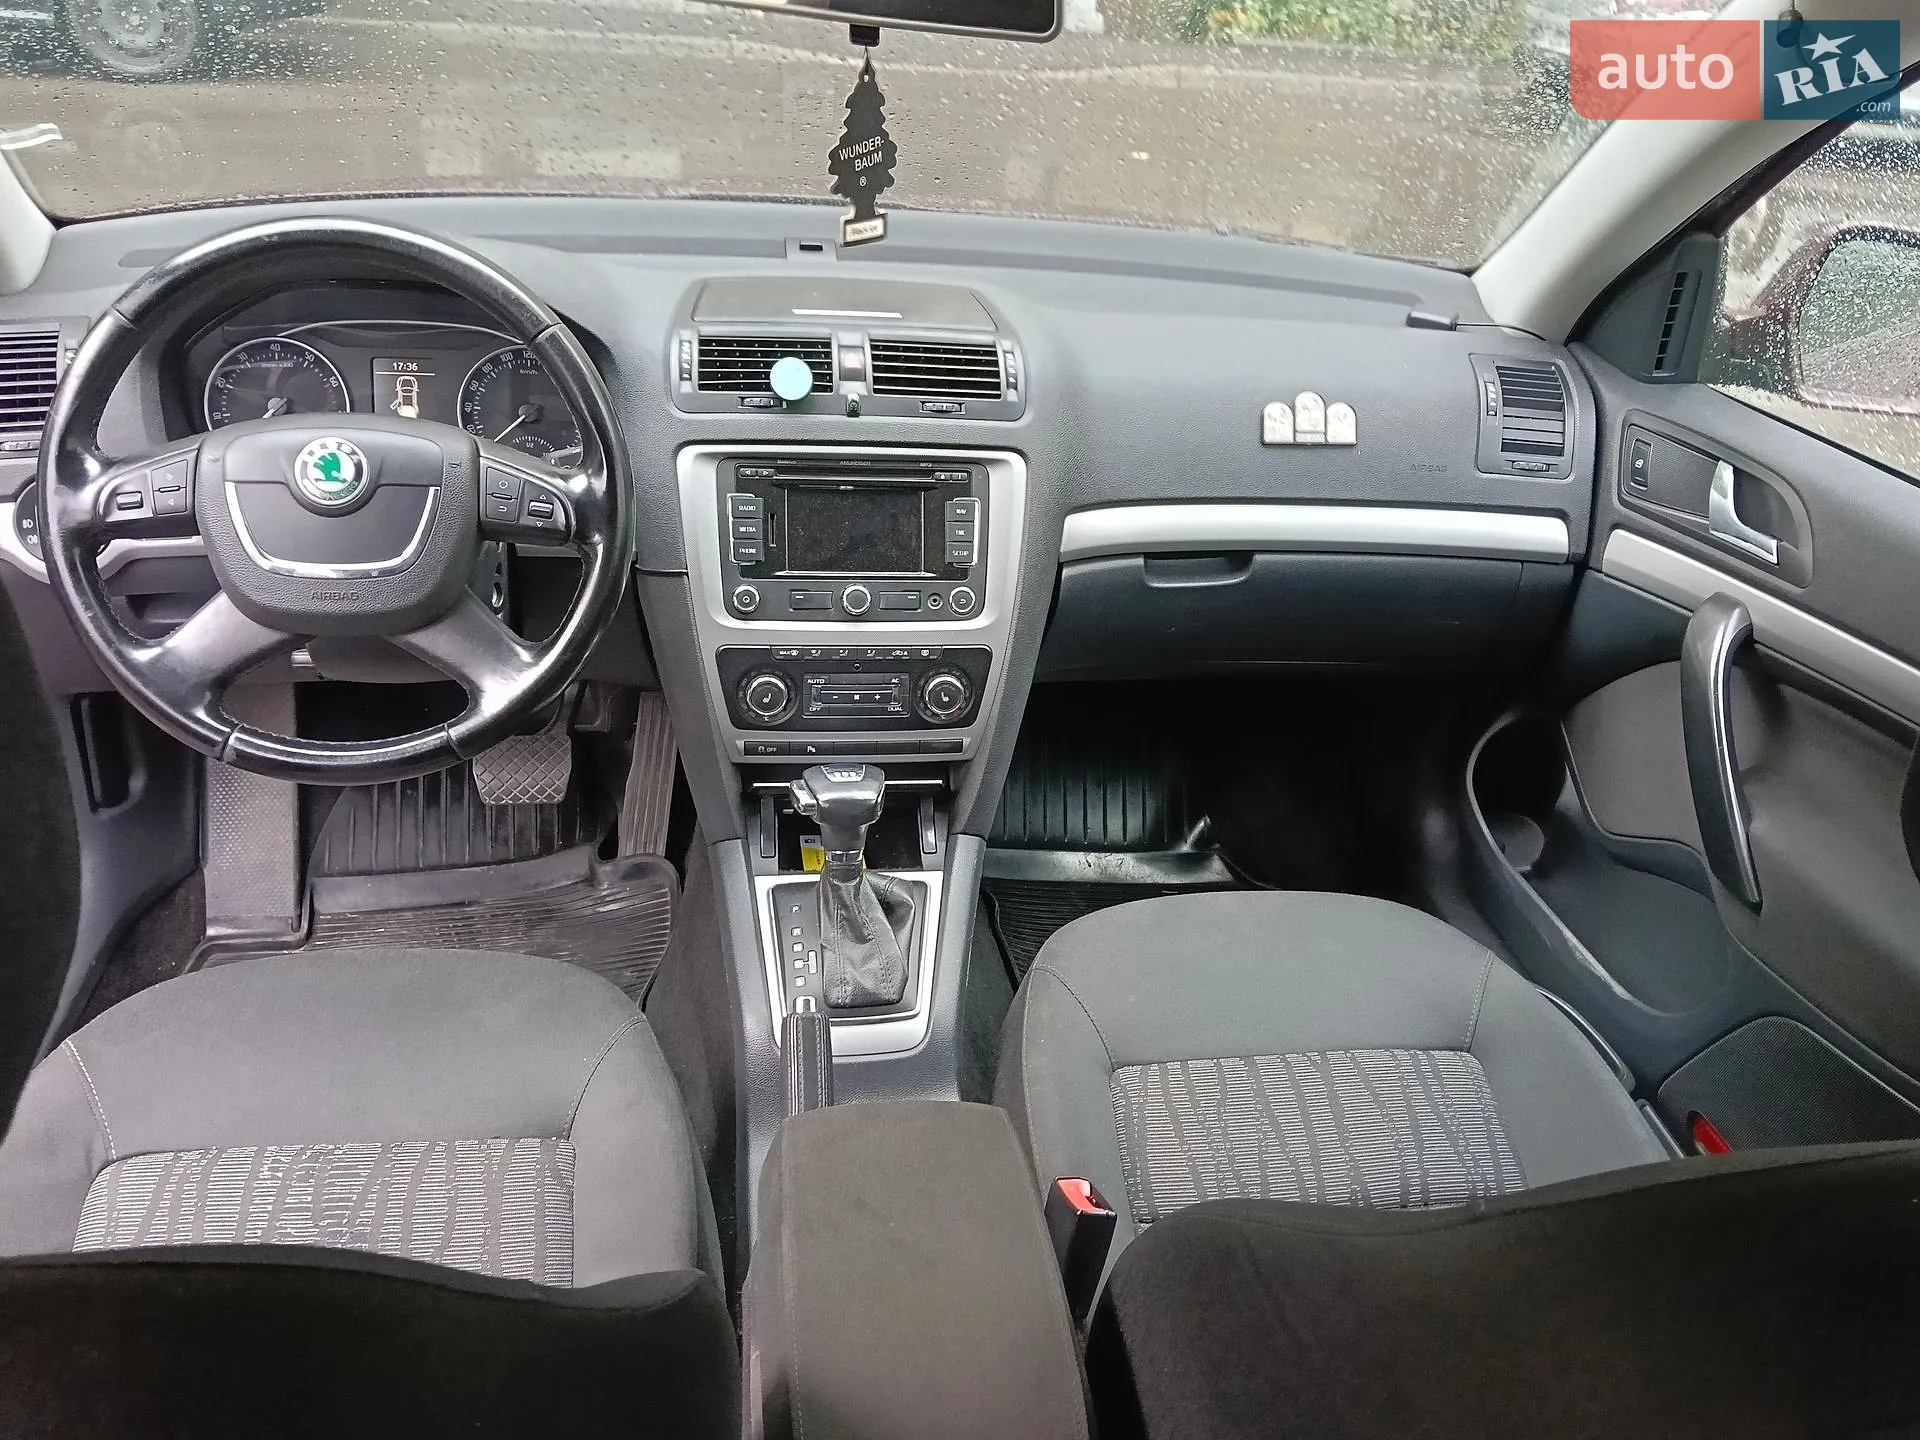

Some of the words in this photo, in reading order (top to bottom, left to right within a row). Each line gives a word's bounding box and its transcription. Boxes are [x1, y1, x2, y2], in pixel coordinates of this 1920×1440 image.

[838, 136, 885, 161] WUNDER-
[854, 151, 883, 172] BAUM
[269, 343, 281, 352] 40
[236, 351, 248, 362] 30
[304, 351, 315, 362] 50
[499, 351, 514, 363] 100
[392, 361, 419, 371] 17:36
[482, 362, 493, 374] 80
[215, 376, 226, 389] 20
[329, 376, 339, 388] 60
[469, 379, 479, 391] 60
[464, 402, 473, 413] 40
[311, 590, 361, 601] AIRBAG
